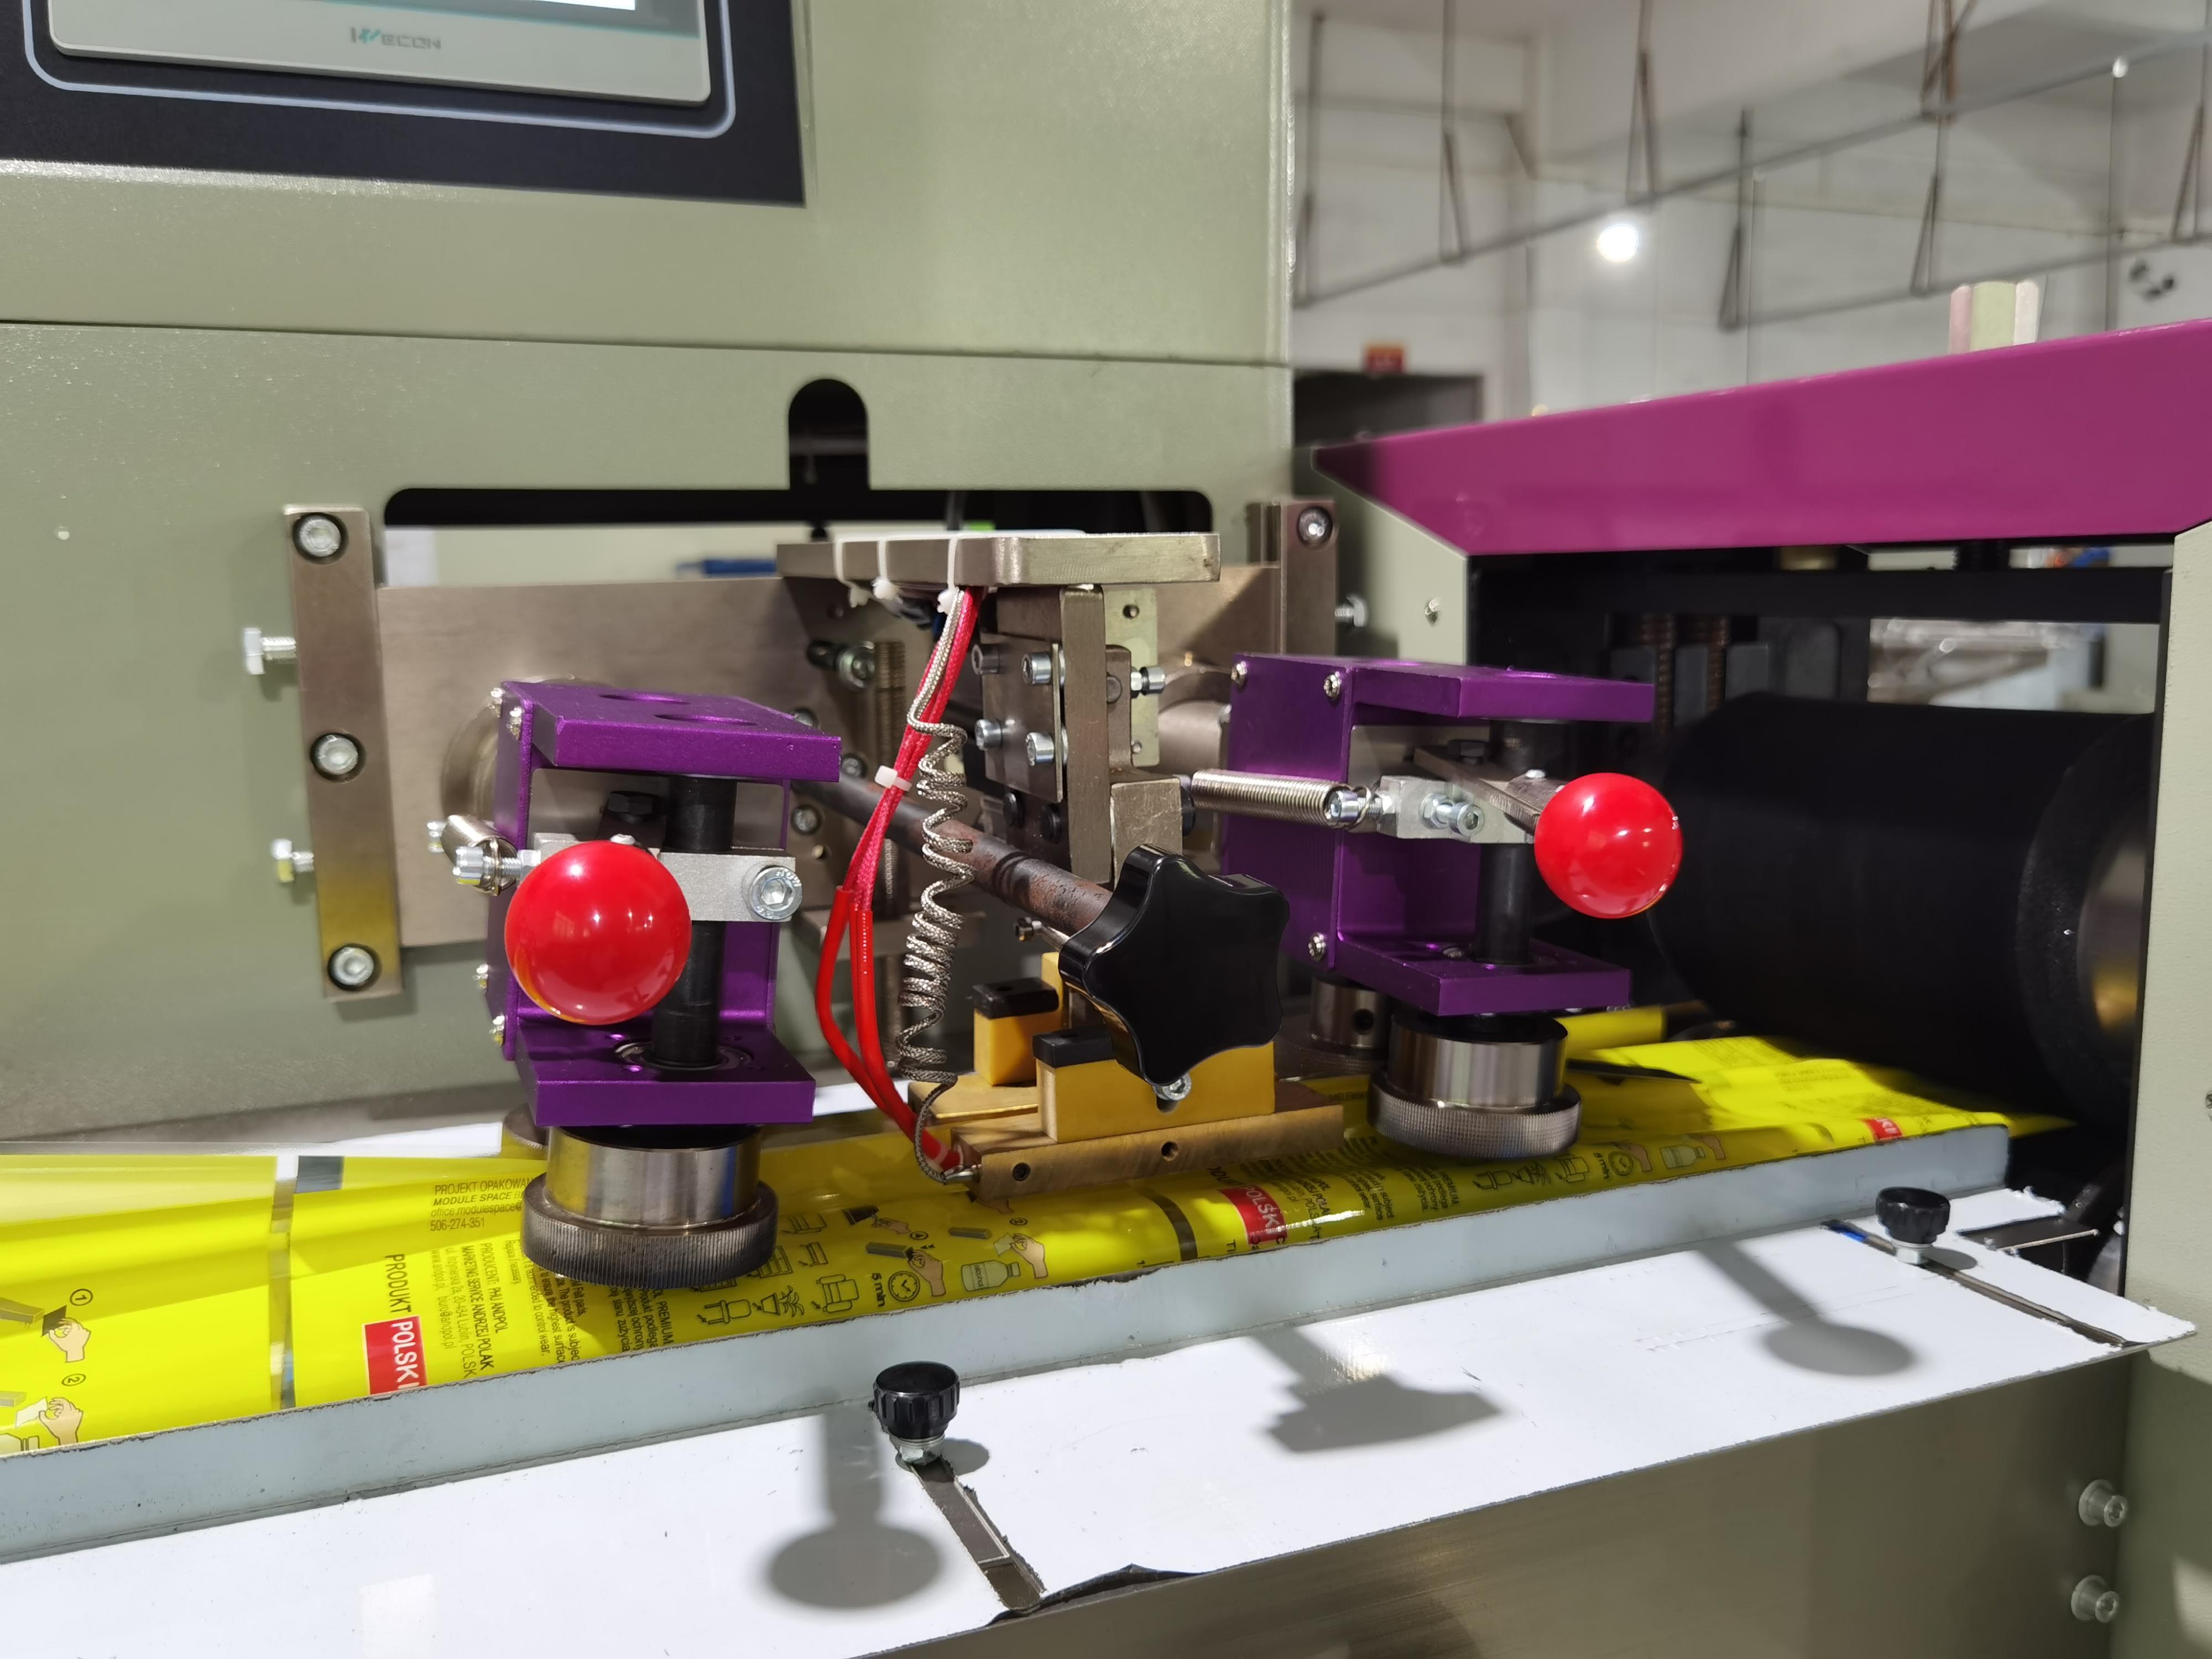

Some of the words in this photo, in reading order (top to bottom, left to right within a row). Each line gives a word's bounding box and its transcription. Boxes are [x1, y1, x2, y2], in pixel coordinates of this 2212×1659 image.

[433, 1194, 478, 1207] MODULE
[479, 1191, 513, 1202] SPACE
[435, 1182, 478, 1196] PROJEKT
[430, 1217, 486, 1232] 506-274-351
[461, 1245, 481, 1279] MARKETING
[479, 1242, 500, 1286] PRODUCENT:
[384, 1253, 412, 1314] PRODUKT
[872, 1272, 882, 1281] 5
[467, 1278, 484, 1303] SERVICE
[488, 1286, 504, 1302] PHU
[874, 1282, 886, 1308] min
[453, 1295, 468, 1318] 20-484
[491, 1302, 509, 1334] ANDPOL
[437, 1295, 457, 1349] biuro@andpol.pl
[456, 1318, 471, 1343] Lublin,
[471, 1303, 489, 1337] ANDRZEJ
[391, 1321, 420, 1390] POLSKI
[477, 1337, 495, 1371] POLAK
